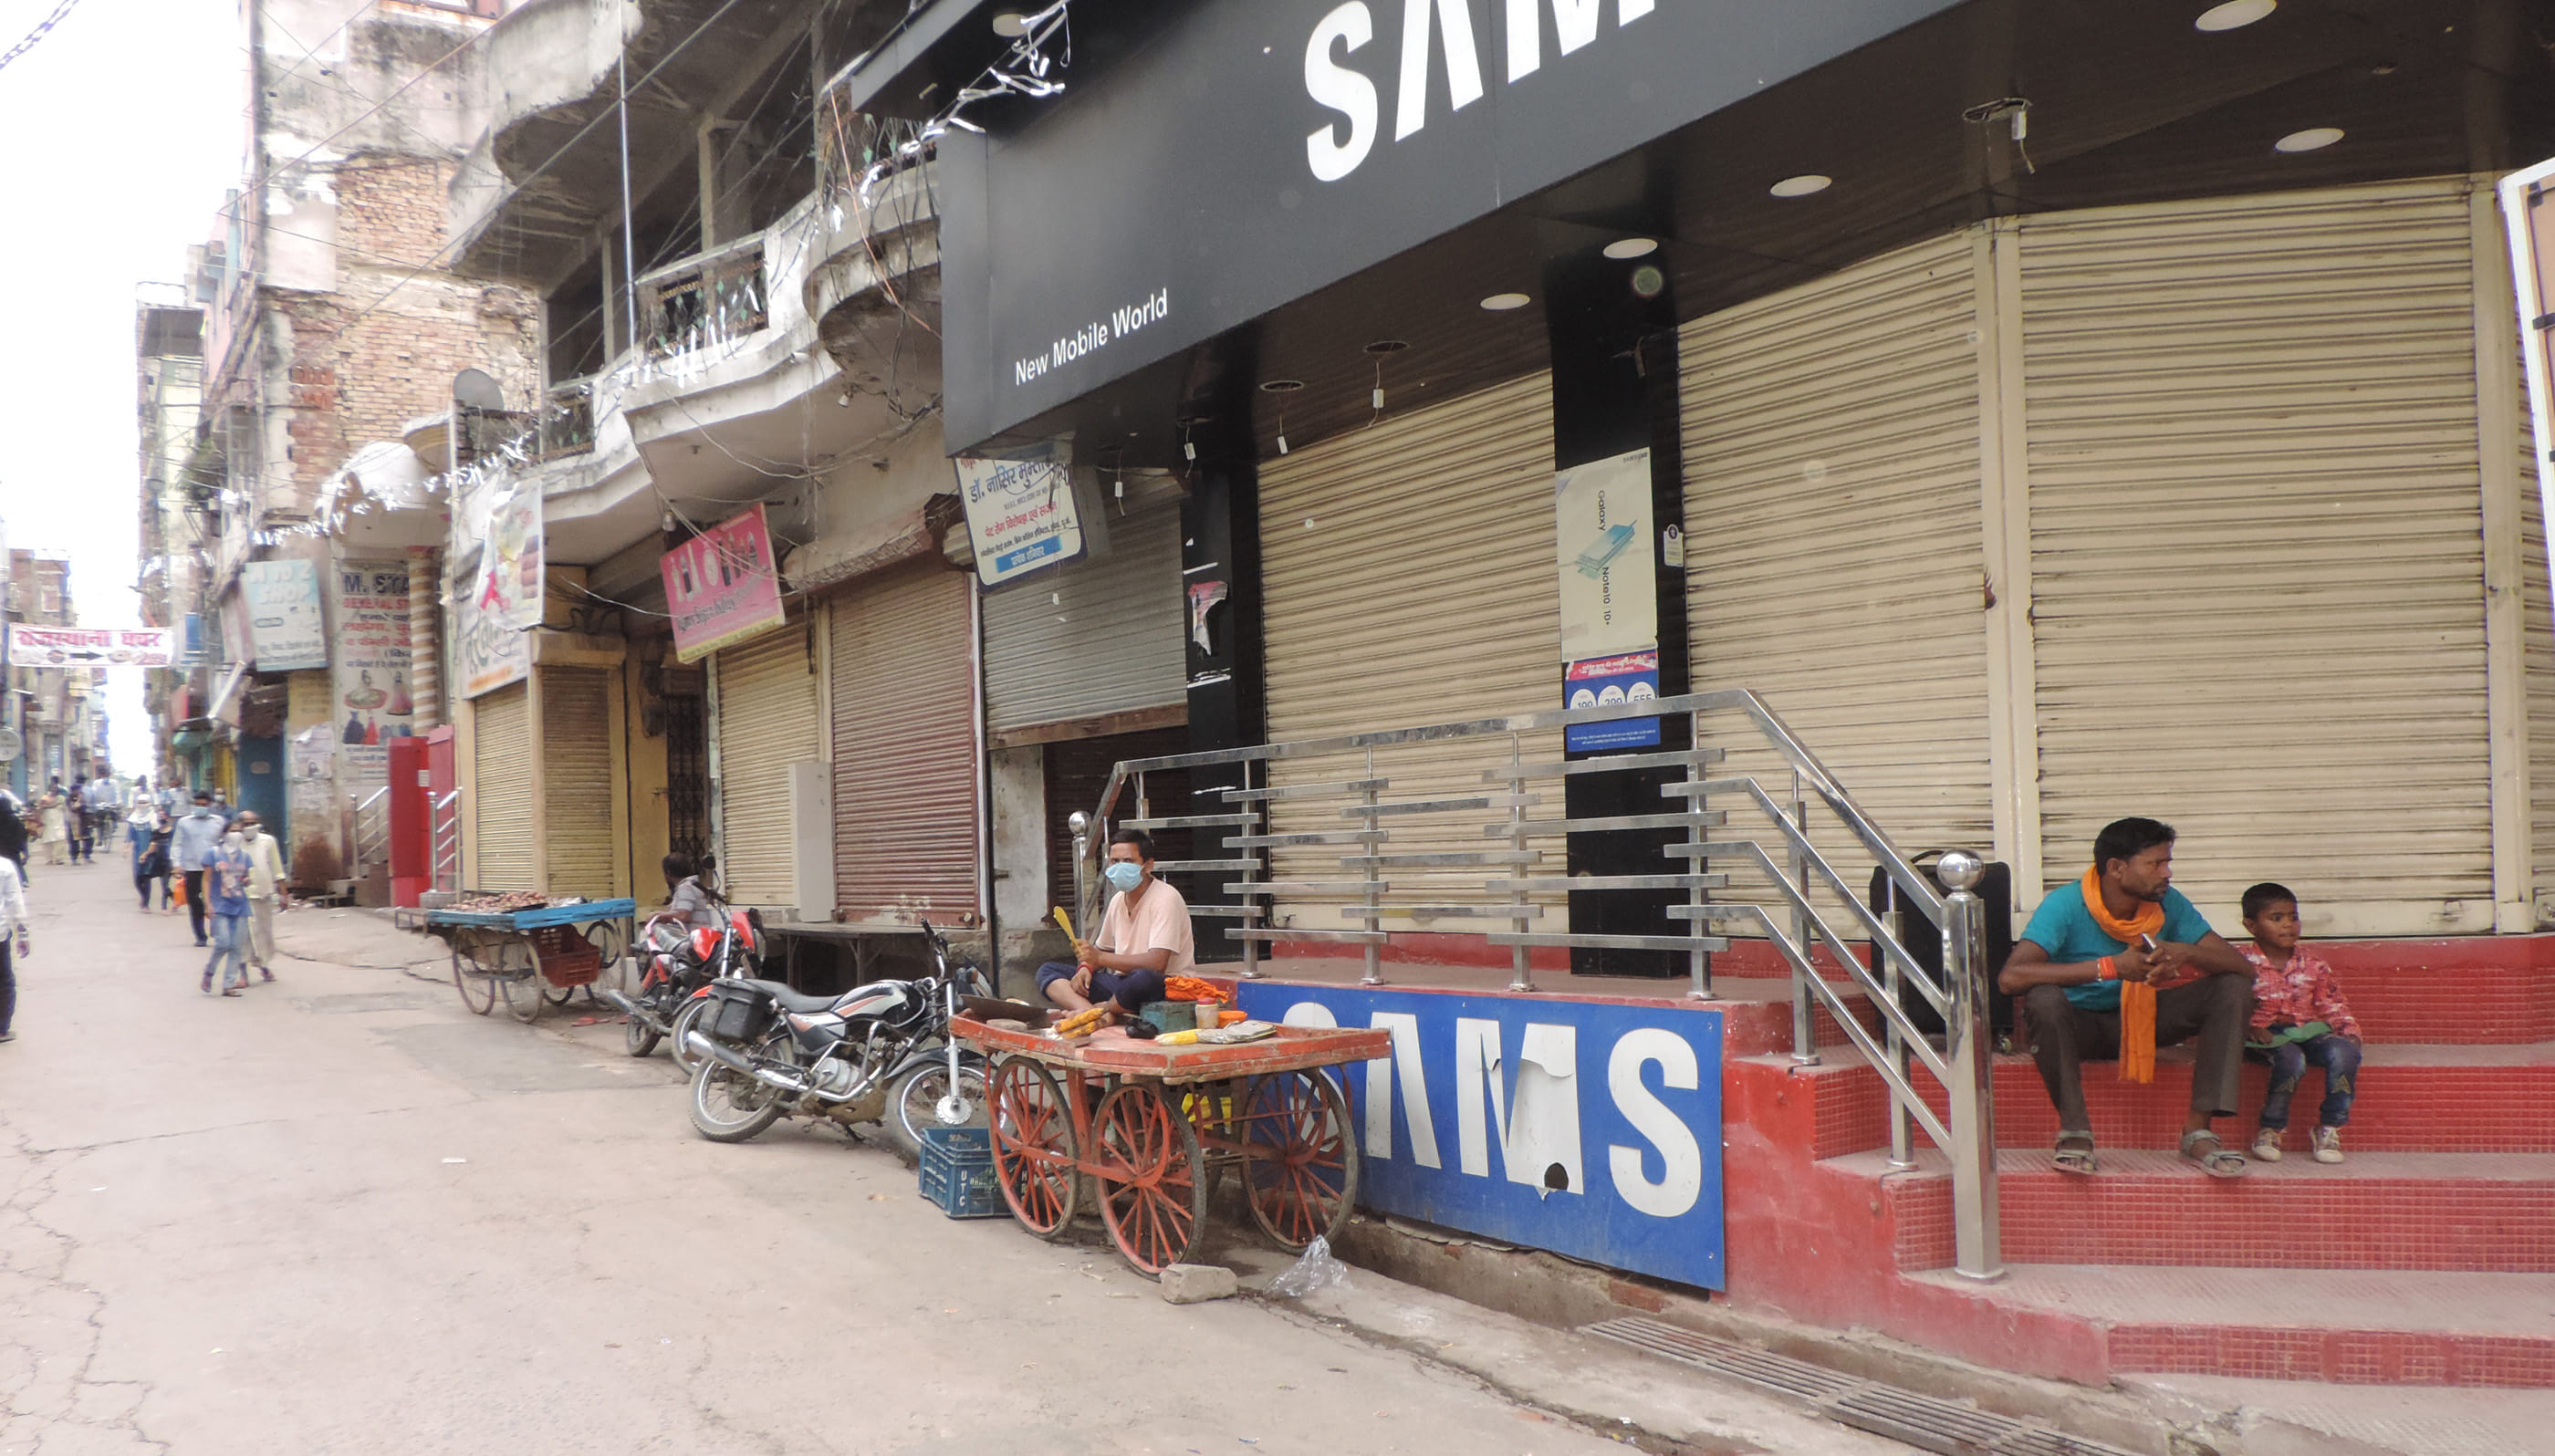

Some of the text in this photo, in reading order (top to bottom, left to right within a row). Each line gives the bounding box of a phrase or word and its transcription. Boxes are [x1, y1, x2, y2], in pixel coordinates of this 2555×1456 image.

[1016, 287, 1167, 386] New Mobile World
[969, 477, 985, 503] डॉ.
[986, 465, 1017, 494] नासिर
[1598, 490, 1606, 531] Galaxy
[959, 1170, 967, 1207] UTC
